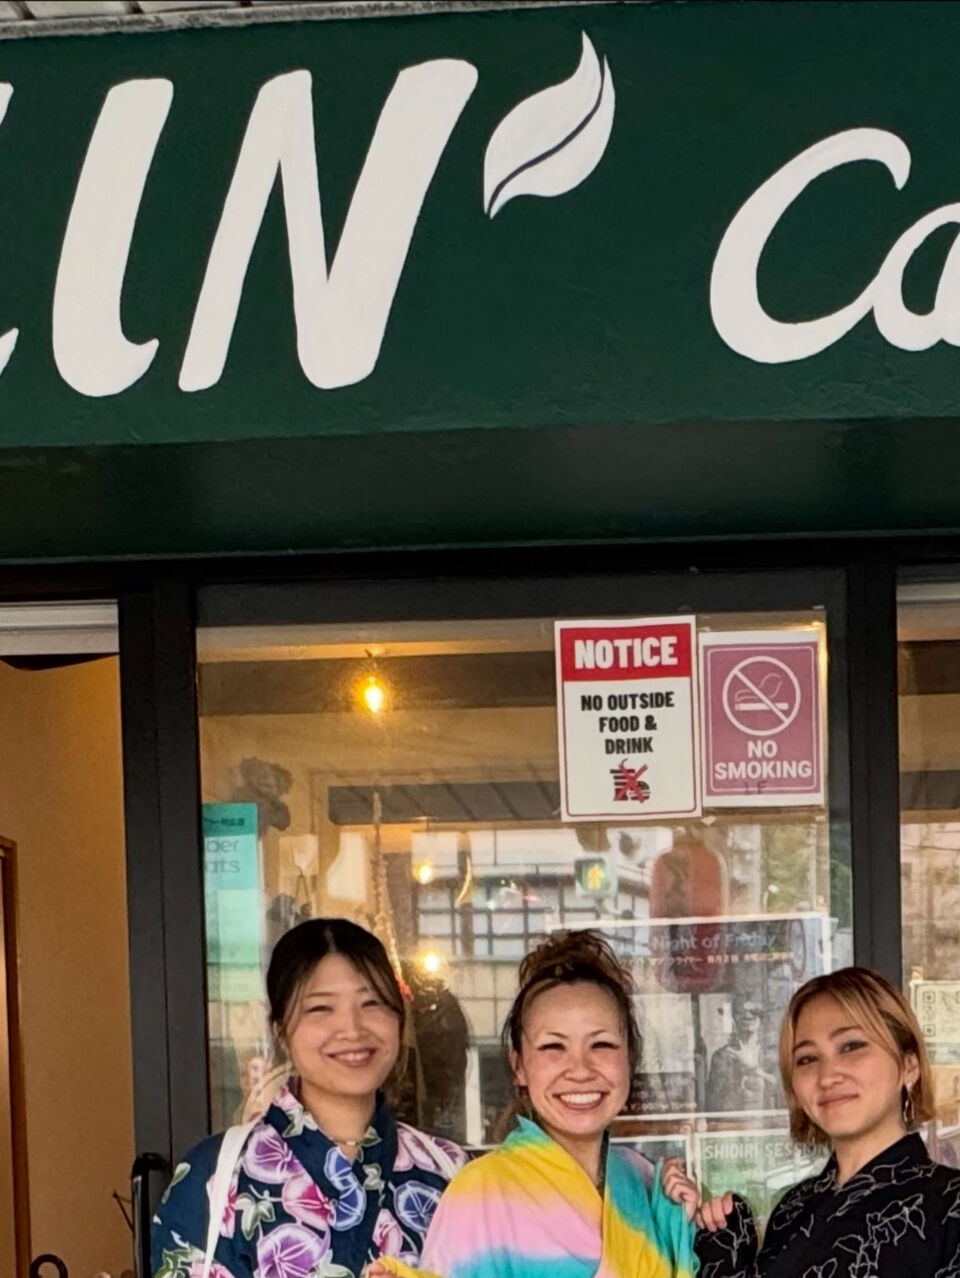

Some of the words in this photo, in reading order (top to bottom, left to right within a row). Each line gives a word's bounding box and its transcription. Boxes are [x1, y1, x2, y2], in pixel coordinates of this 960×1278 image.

[574, 636, 678, 669] NOTICE
[580, 694, 603, 711] NO
[607, 691, 675, 711] OUTSIDE
[598, 715, 640, 733] FOOD
[644, 714, 657, 731] &
[604, 736, 654, 755] DRINK
[747, 740, 778, 758] NO
[714, 760, 812, 780] SMOKING
[653, 933, 698, 951] Night
[702, 934, 720, 950] of
